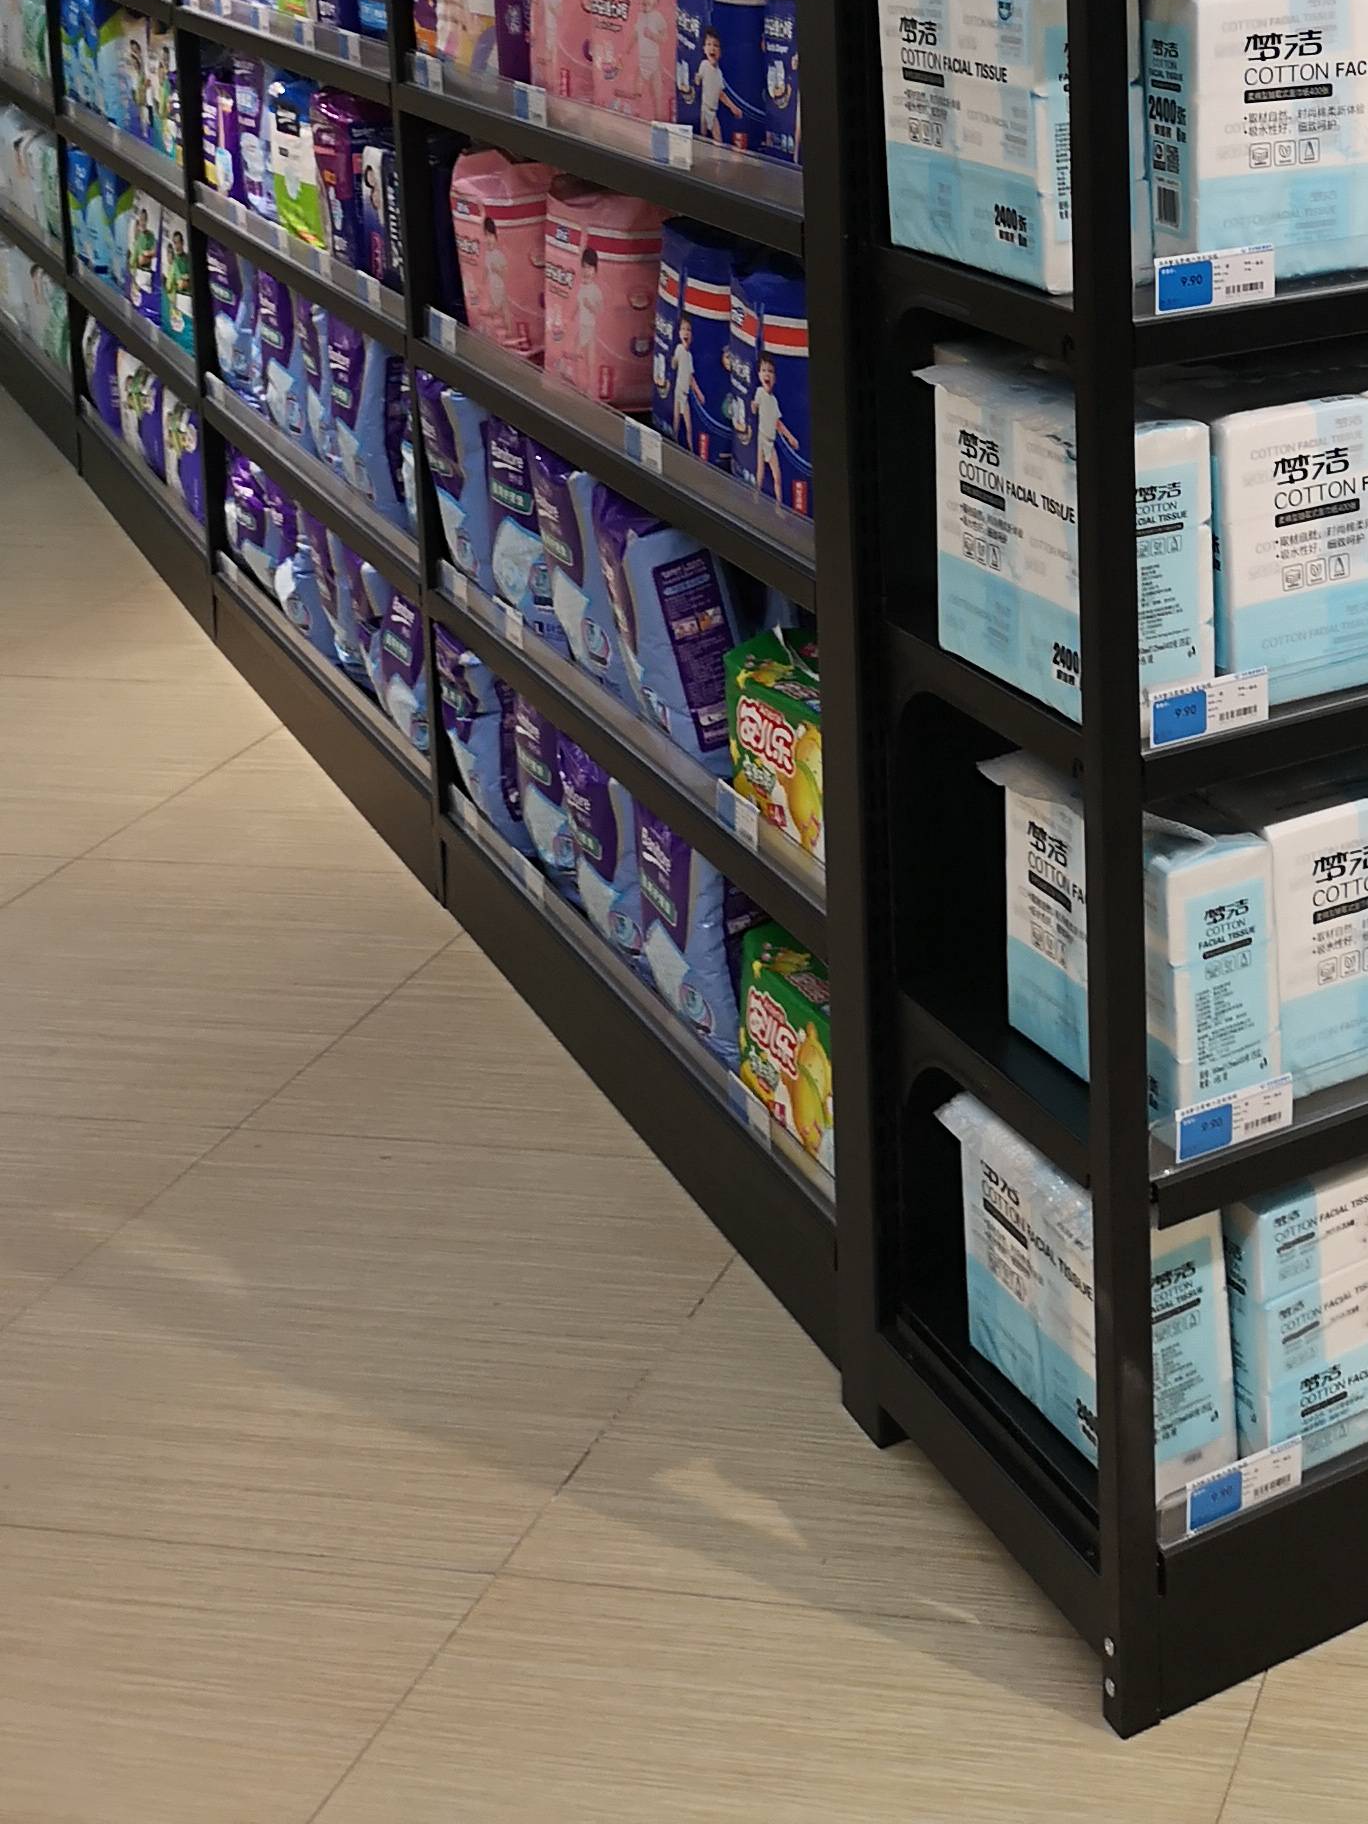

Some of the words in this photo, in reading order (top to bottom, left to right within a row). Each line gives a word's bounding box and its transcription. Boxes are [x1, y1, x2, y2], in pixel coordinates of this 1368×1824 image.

[900, 16, 937, 45] 梦洁
[1245, 29, 1322, 61] 梦洁
[901, 47, 943, 72] COTTON
[943, 56, 972, 76] FACIAL
[975, 61, 1008, 83] TISSUE
[1244, 62, 1330, 86] COTTON
[1148, 95, 1186, 126] 2400张
[959, 430, 999, 466] 梦洁
[1274, 447, 1350, 486] 梦洁
[959, 460, 1004, 493] COTTON
[1006, 481, 1039, 508] FACIAL
[1042, 494, 1076, 523] TISSUE
[1274, 477, 1357, 509] COTTON
[1204, 899, 1249, 926] 梦洁
[1206, 918, 1246, 937] COTTON
[1198, 933, 1226, 951] FACIAL
[1228, 926, 1256, 943] TISSUE
